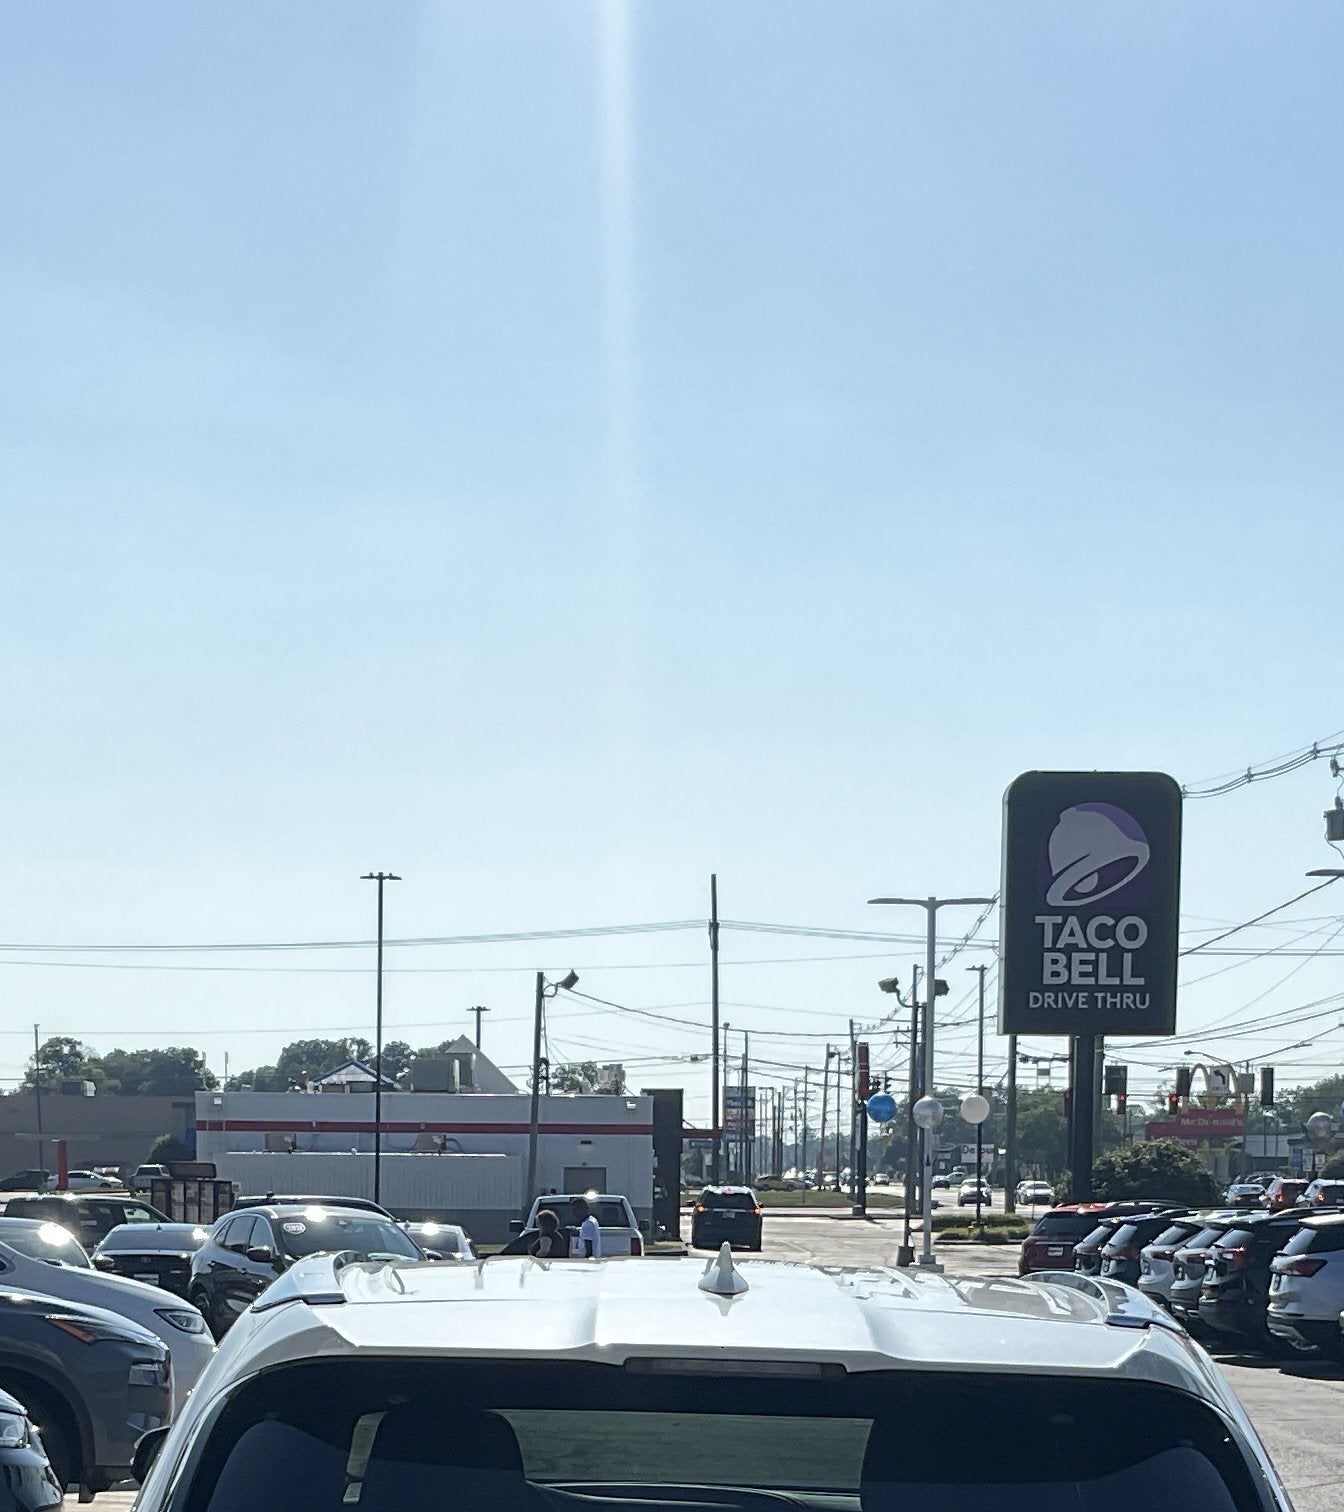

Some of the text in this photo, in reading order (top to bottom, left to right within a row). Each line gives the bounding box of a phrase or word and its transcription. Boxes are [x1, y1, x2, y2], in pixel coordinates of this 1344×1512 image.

[1035, 915, 1148, 949] TACO
[1042, 952, 1145, 985] BELL
[1029, 991, 1150, 1009] DRIVE THRU
